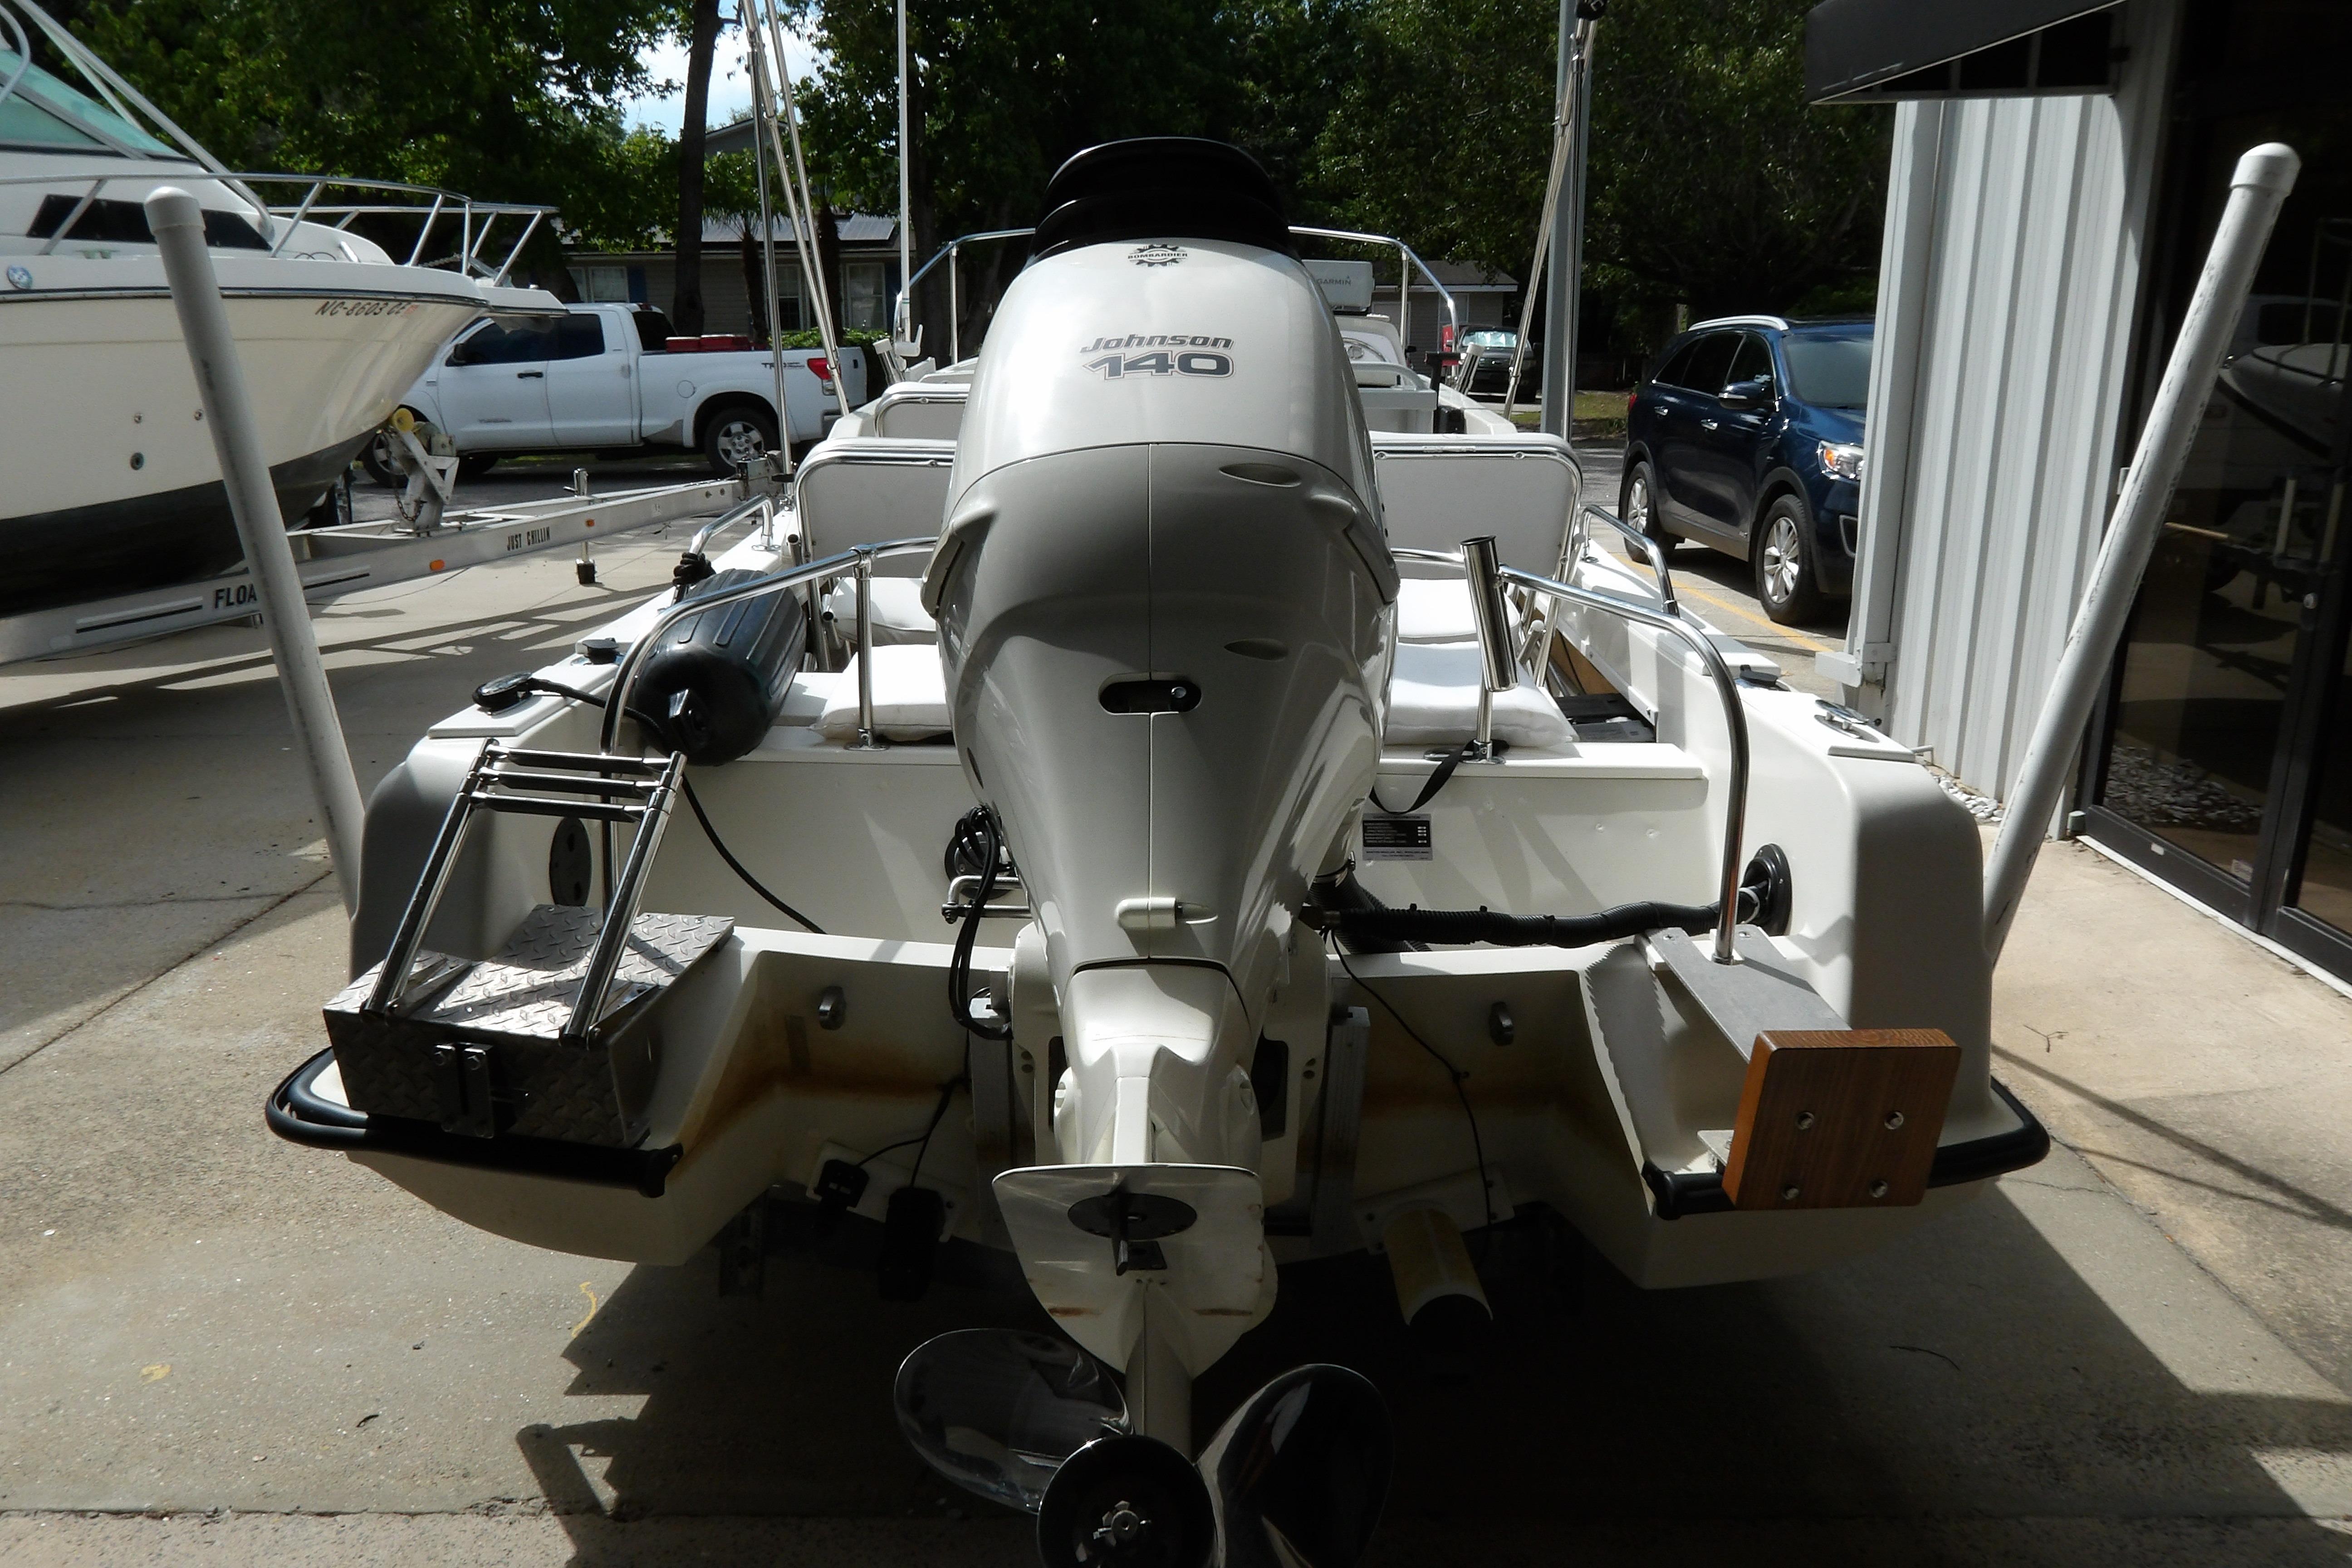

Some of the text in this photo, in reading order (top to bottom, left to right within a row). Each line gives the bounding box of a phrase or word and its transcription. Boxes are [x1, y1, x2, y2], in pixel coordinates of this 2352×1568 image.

[1316, 277, 1352, 286] GARMIN
[1079, 333, 1235, 353] Johnson
[1082, 350, 1234, 380] 140
[507, 526, 551, 551] JUST CHILLIN
[215, 583, 257, 609] FLOA
